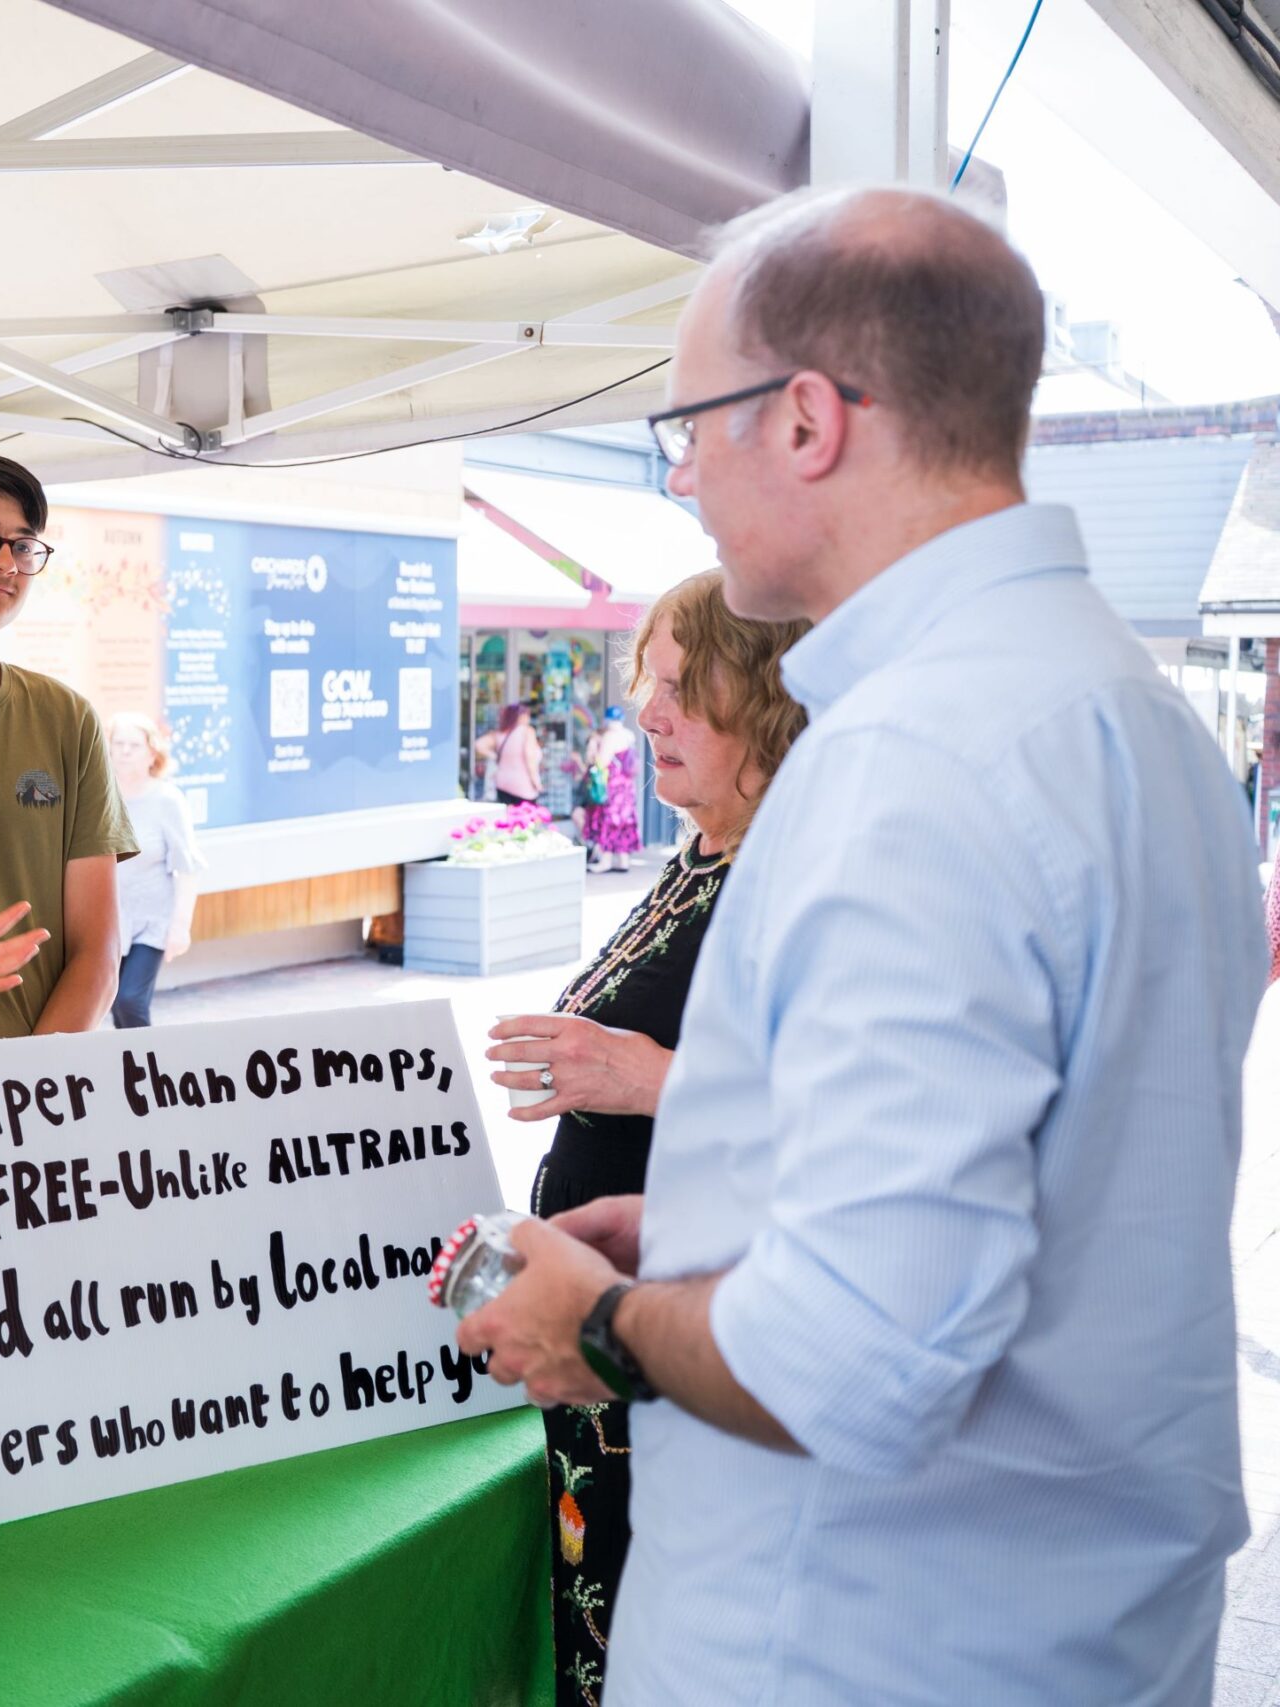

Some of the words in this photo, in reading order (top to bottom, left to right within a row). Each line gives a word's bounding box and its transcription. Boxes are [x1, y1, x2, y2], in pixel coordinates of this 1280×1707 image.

[122, 1049, 236, 1117] than
[246, 1048, 301, 1099] OS
[312, 1048, 453, 1094] maps,
[43, 1279, 110, 1341] all
[120, 1280, 199, 1328] run
[210, 1259, 261, 1326] by
[281, 1371, 330, 1422] to
[339, 1349, 435, 1411] help
[439, 1344, 491, 1405] yo
